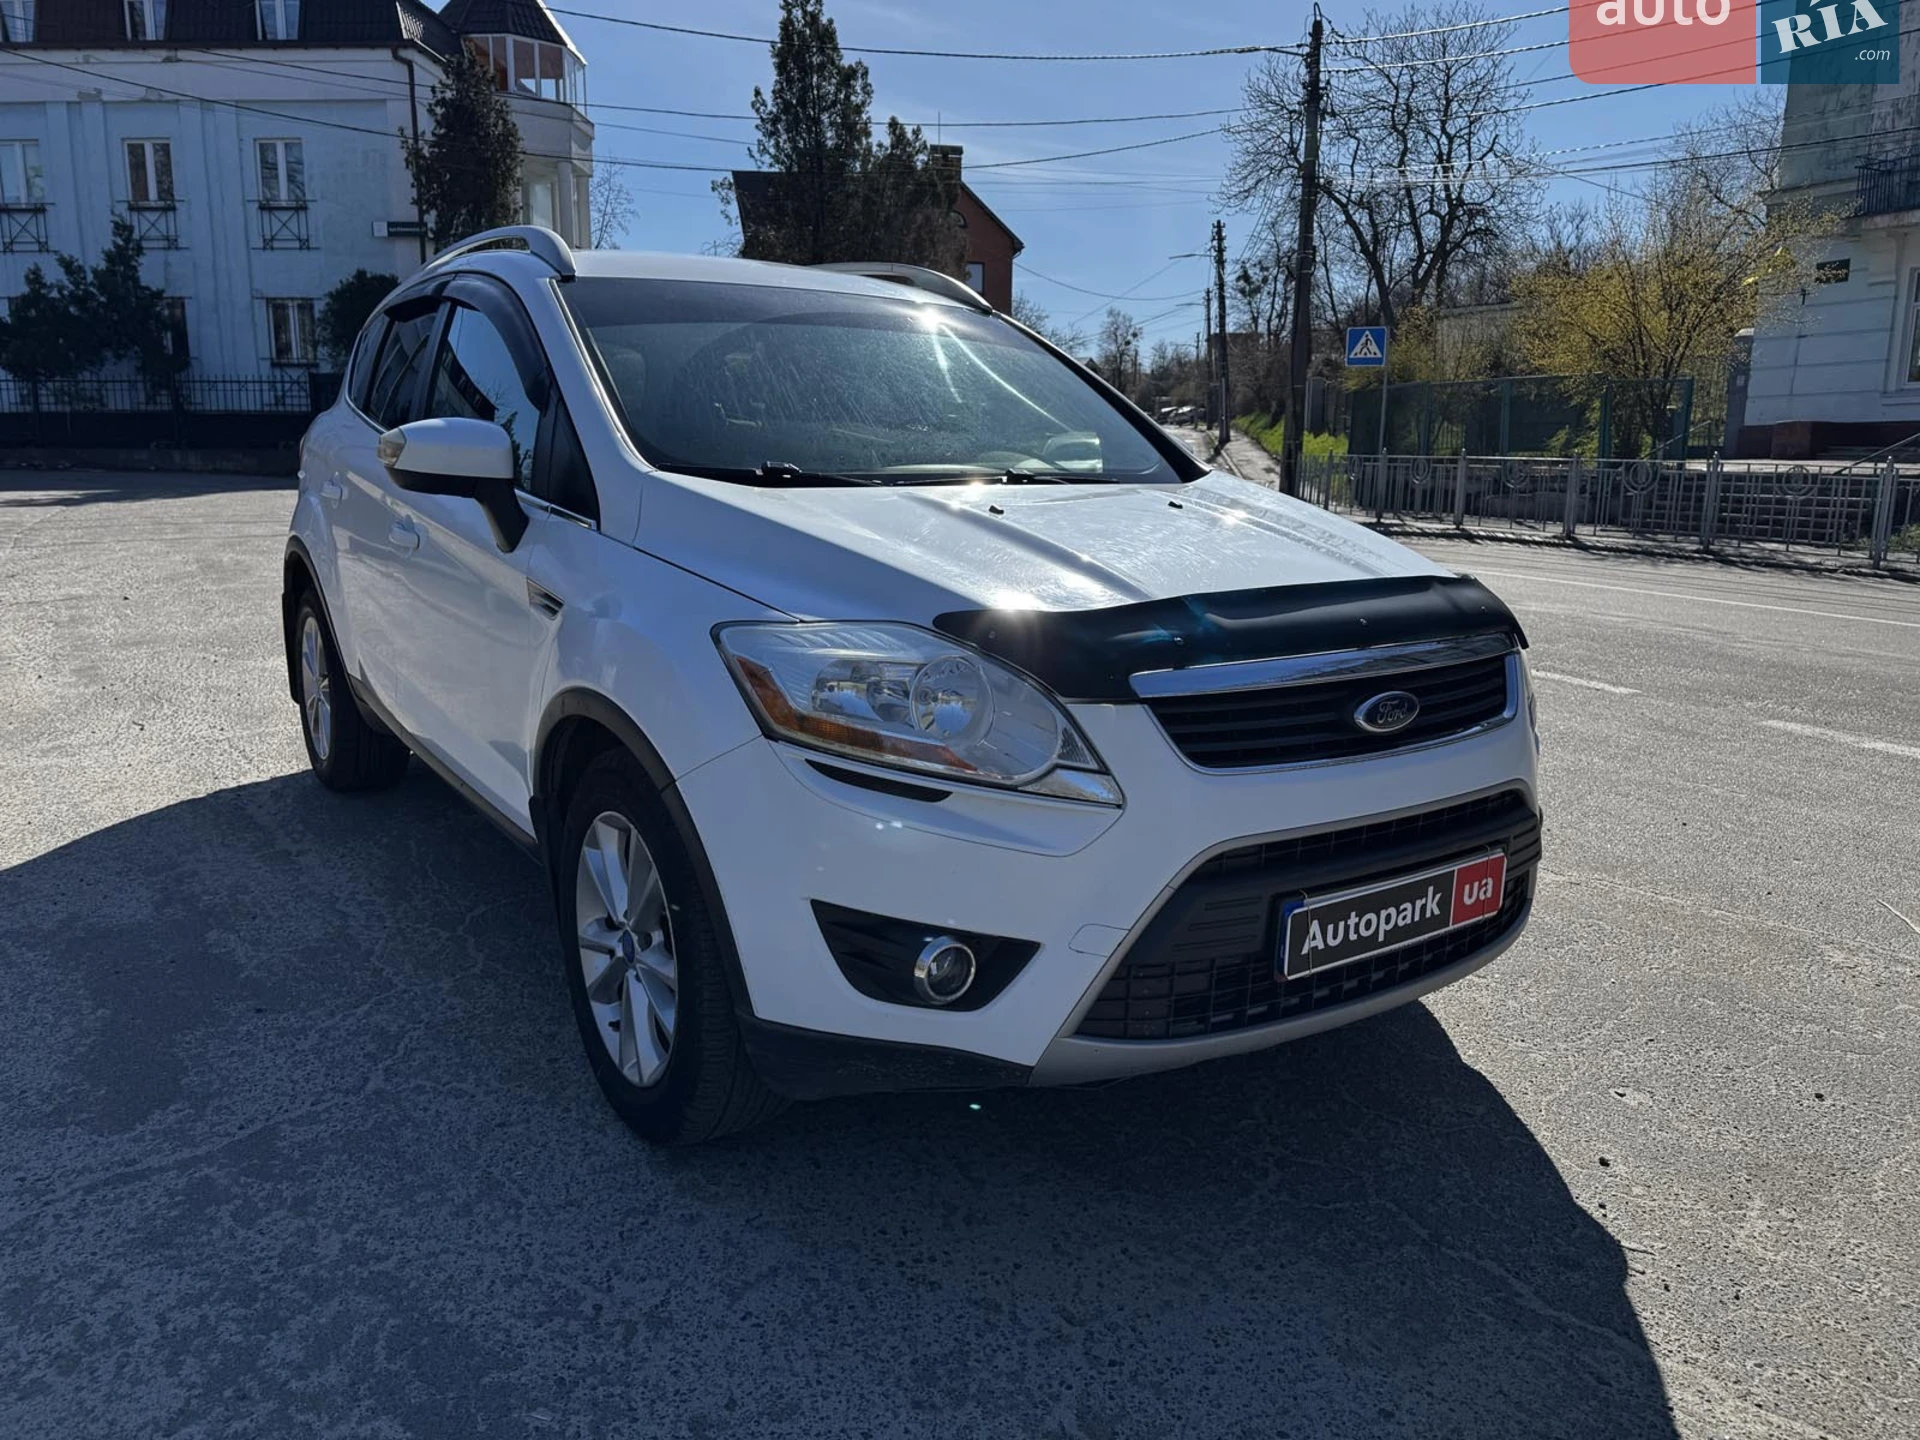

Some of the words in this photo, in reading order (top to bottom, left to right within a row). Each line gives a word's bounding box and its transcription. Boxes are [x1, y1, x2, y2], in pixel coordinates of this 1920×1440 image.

[1377, 700, 1408, 723] Ford
[1301, 886, 1443, 955] Autopark
[1463, 875, 1493, 905] ua
